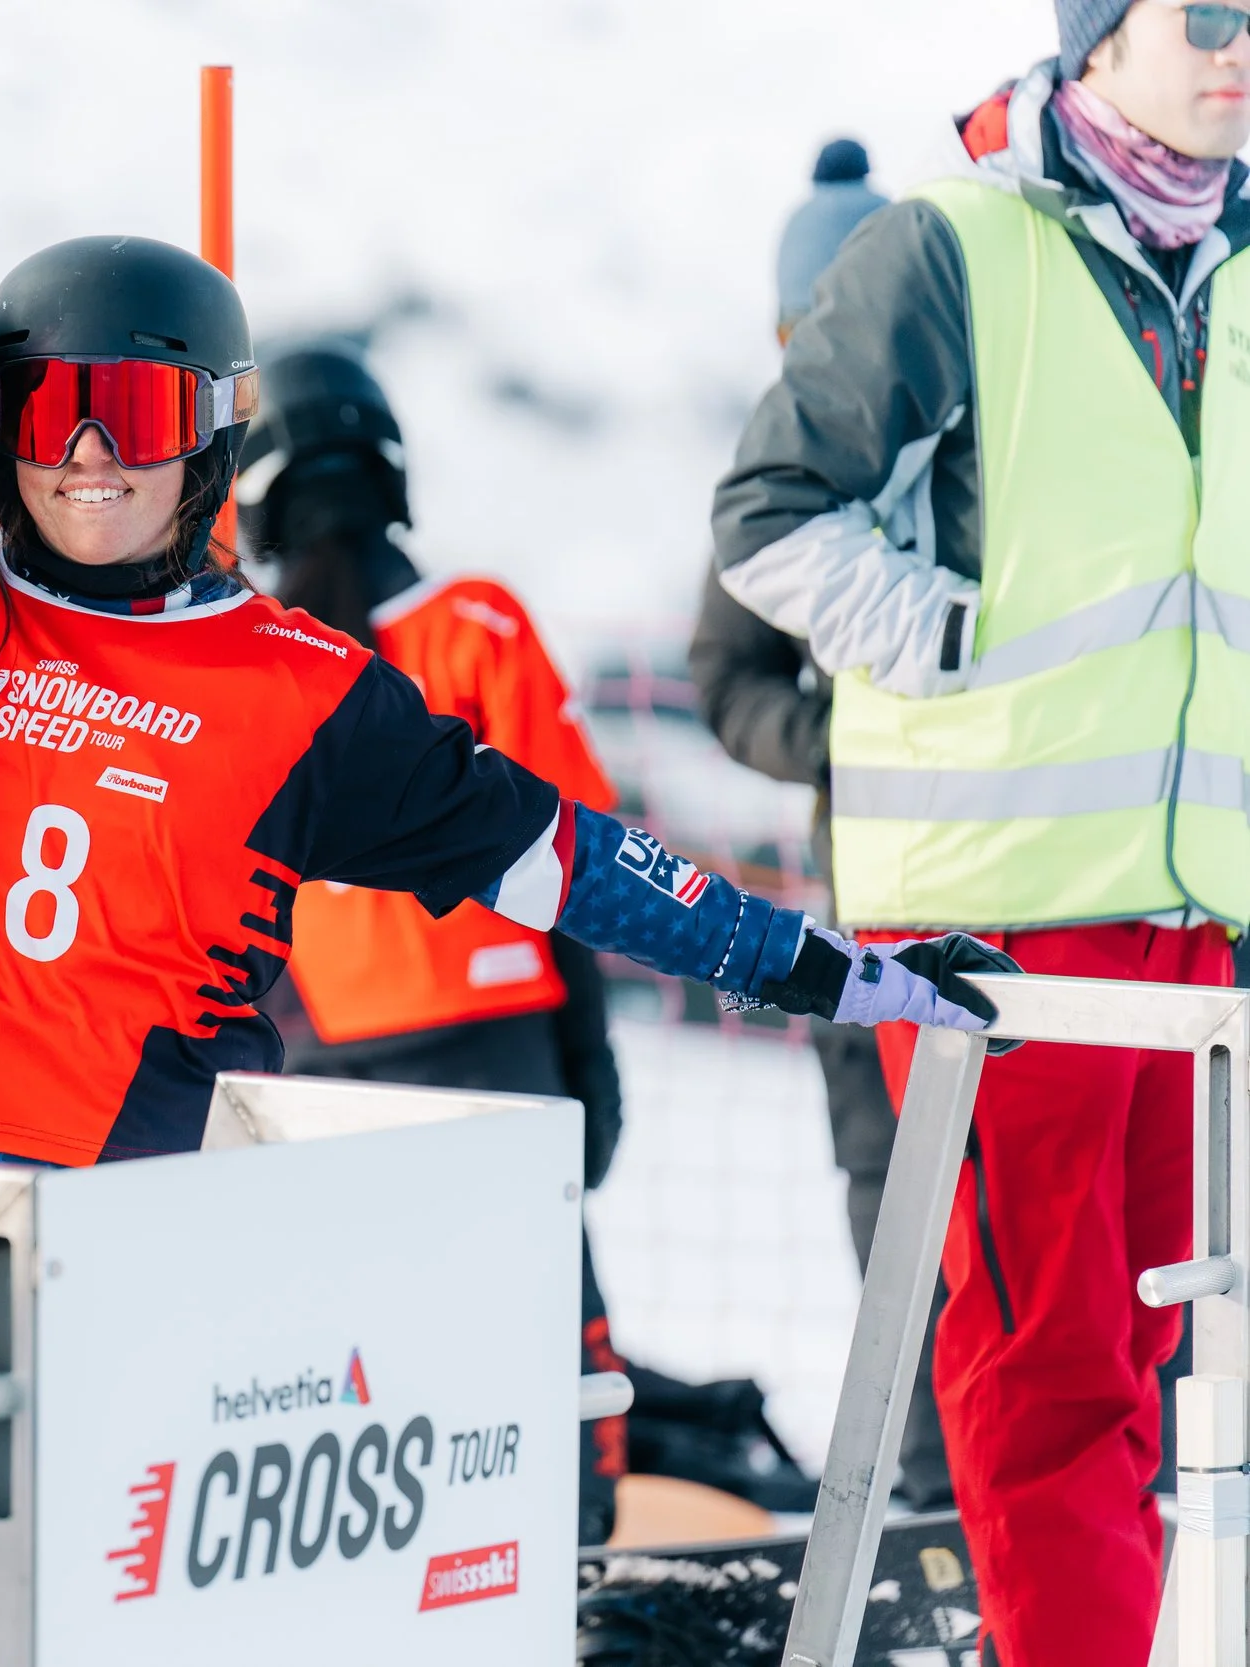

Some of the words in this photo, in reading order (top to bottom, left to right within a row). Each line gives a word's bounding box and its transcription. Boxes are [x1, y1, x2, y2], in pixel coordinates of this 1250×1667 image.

[36, 659, 80, 677] SWISS
[7, 669, 202, 745] SNOWBOARD
[89, 730, 126, 751] TOUR
[105, 774, 164, 796] snowboard
[5, 804, 91, 963] 8
[212, 1368, 333, 1424] helvetia
[186, 1415, 434, 1589] CROSS
[447, 1422, 520, 1486] TOUR
